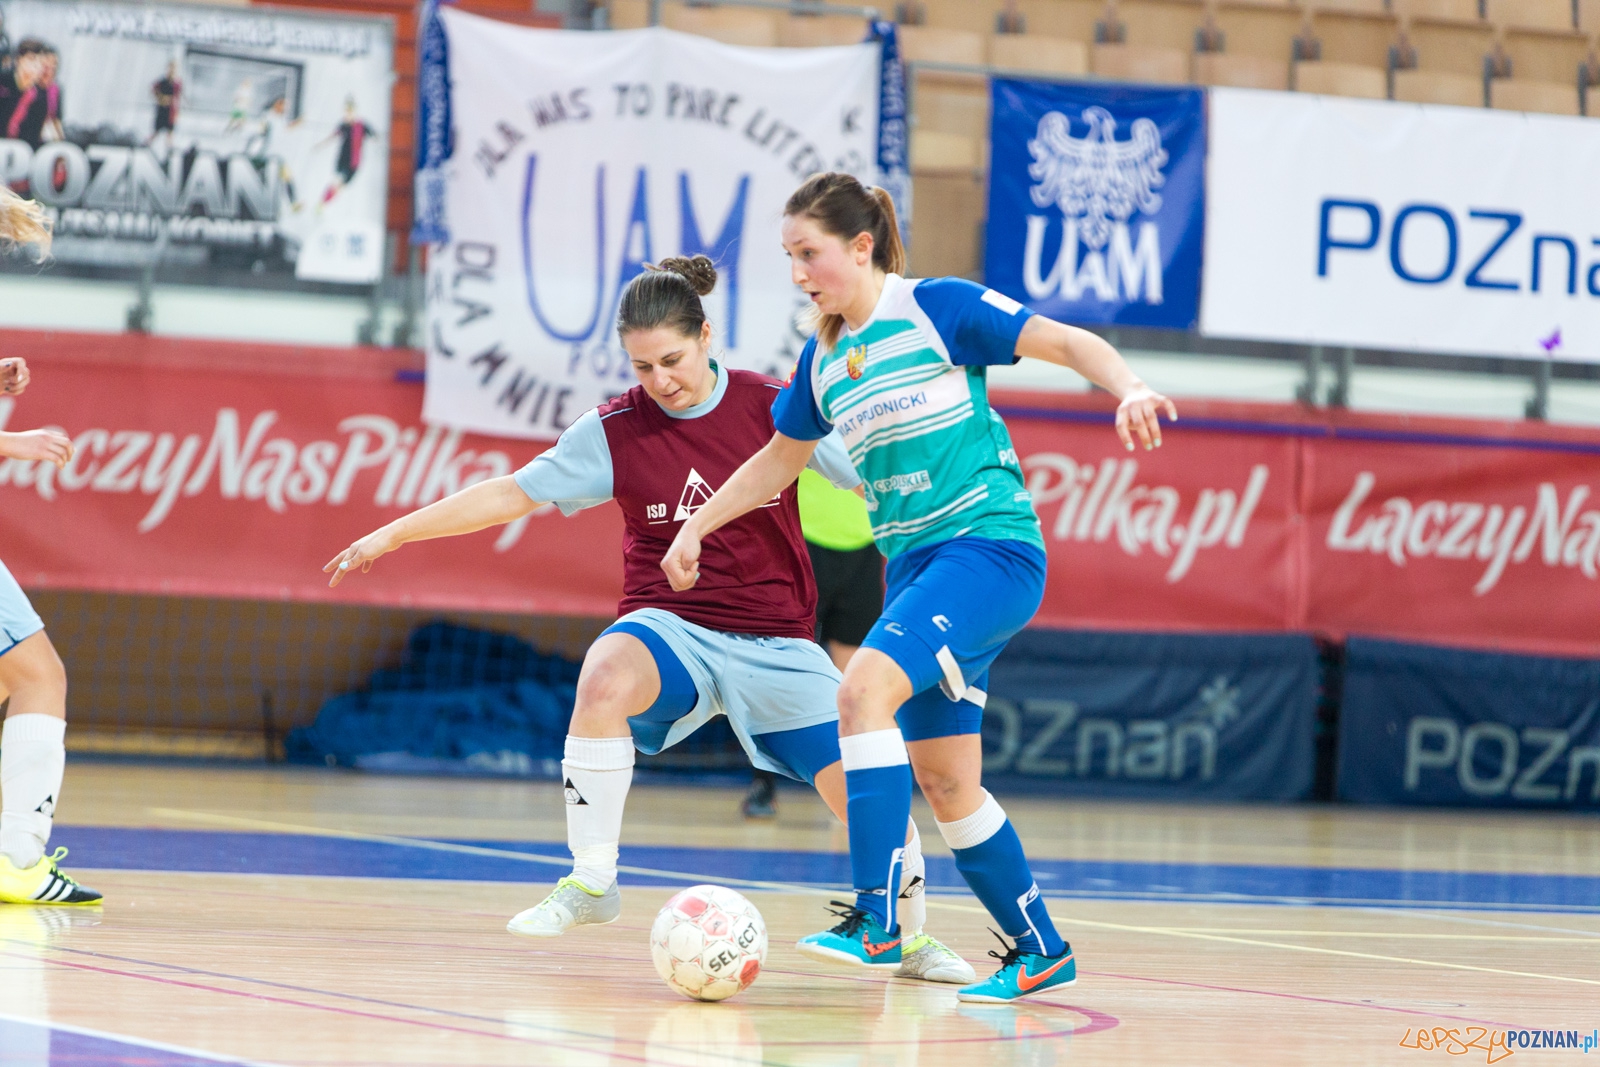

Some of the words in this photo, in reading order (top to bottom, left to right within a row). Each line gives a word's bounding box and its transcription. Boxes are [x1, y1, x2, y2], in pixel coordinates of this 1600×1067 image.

[612, 81, 651, 119] TO
[1022, 212, 1163, 305] UAM
[646, 503, 667, 519] ISD
